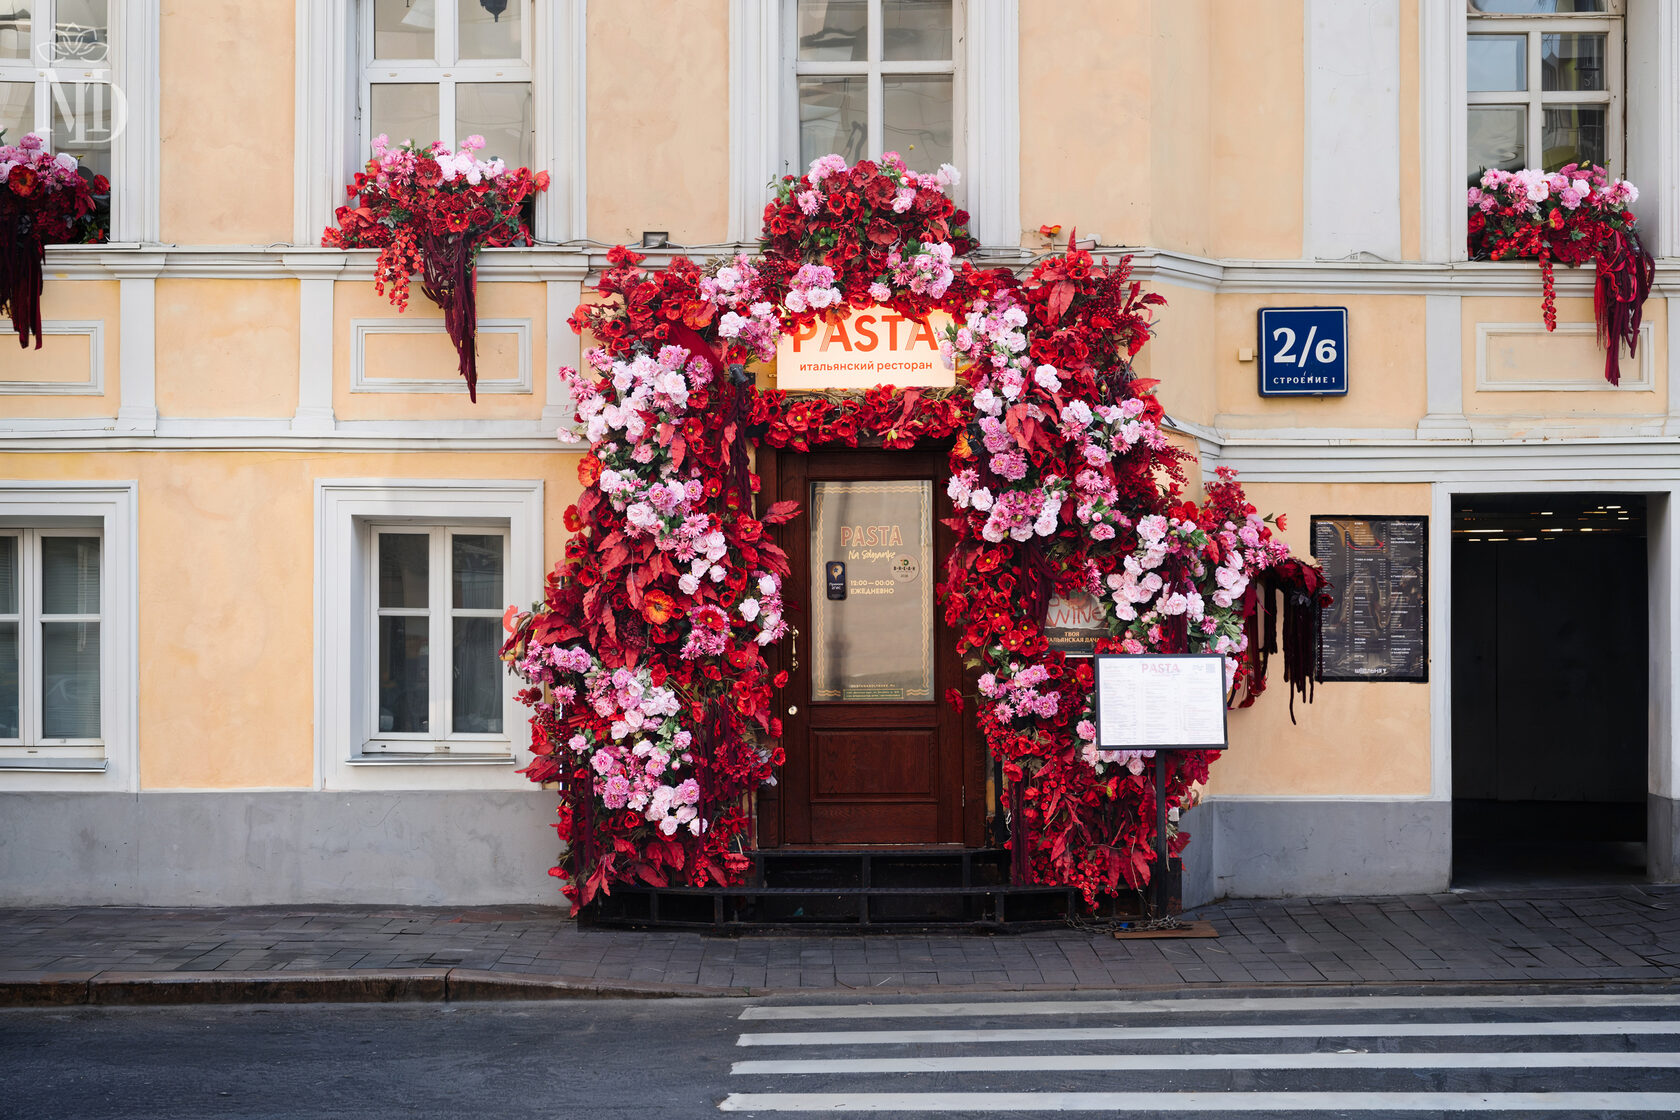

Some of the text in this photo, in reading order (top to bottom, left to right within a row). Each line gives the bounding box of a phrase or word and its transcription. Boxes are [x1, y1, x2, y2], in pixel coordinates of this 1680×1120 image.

[792, 314, 939, 353] PASTA
[1272, 325, 1338, 368] 2/6
[799, 360, 933, 374] итальянский ресторан
[1273, 376, 1328, 384] СТРОЕНИЕ
[840, 525, 903, 547] PASTA
[850, 587, 895, 595] ЕЖЕДНЕВНО
[1046, 602, 1105, 627] WINE
[1141, 663, 1181, 674] PASTA
